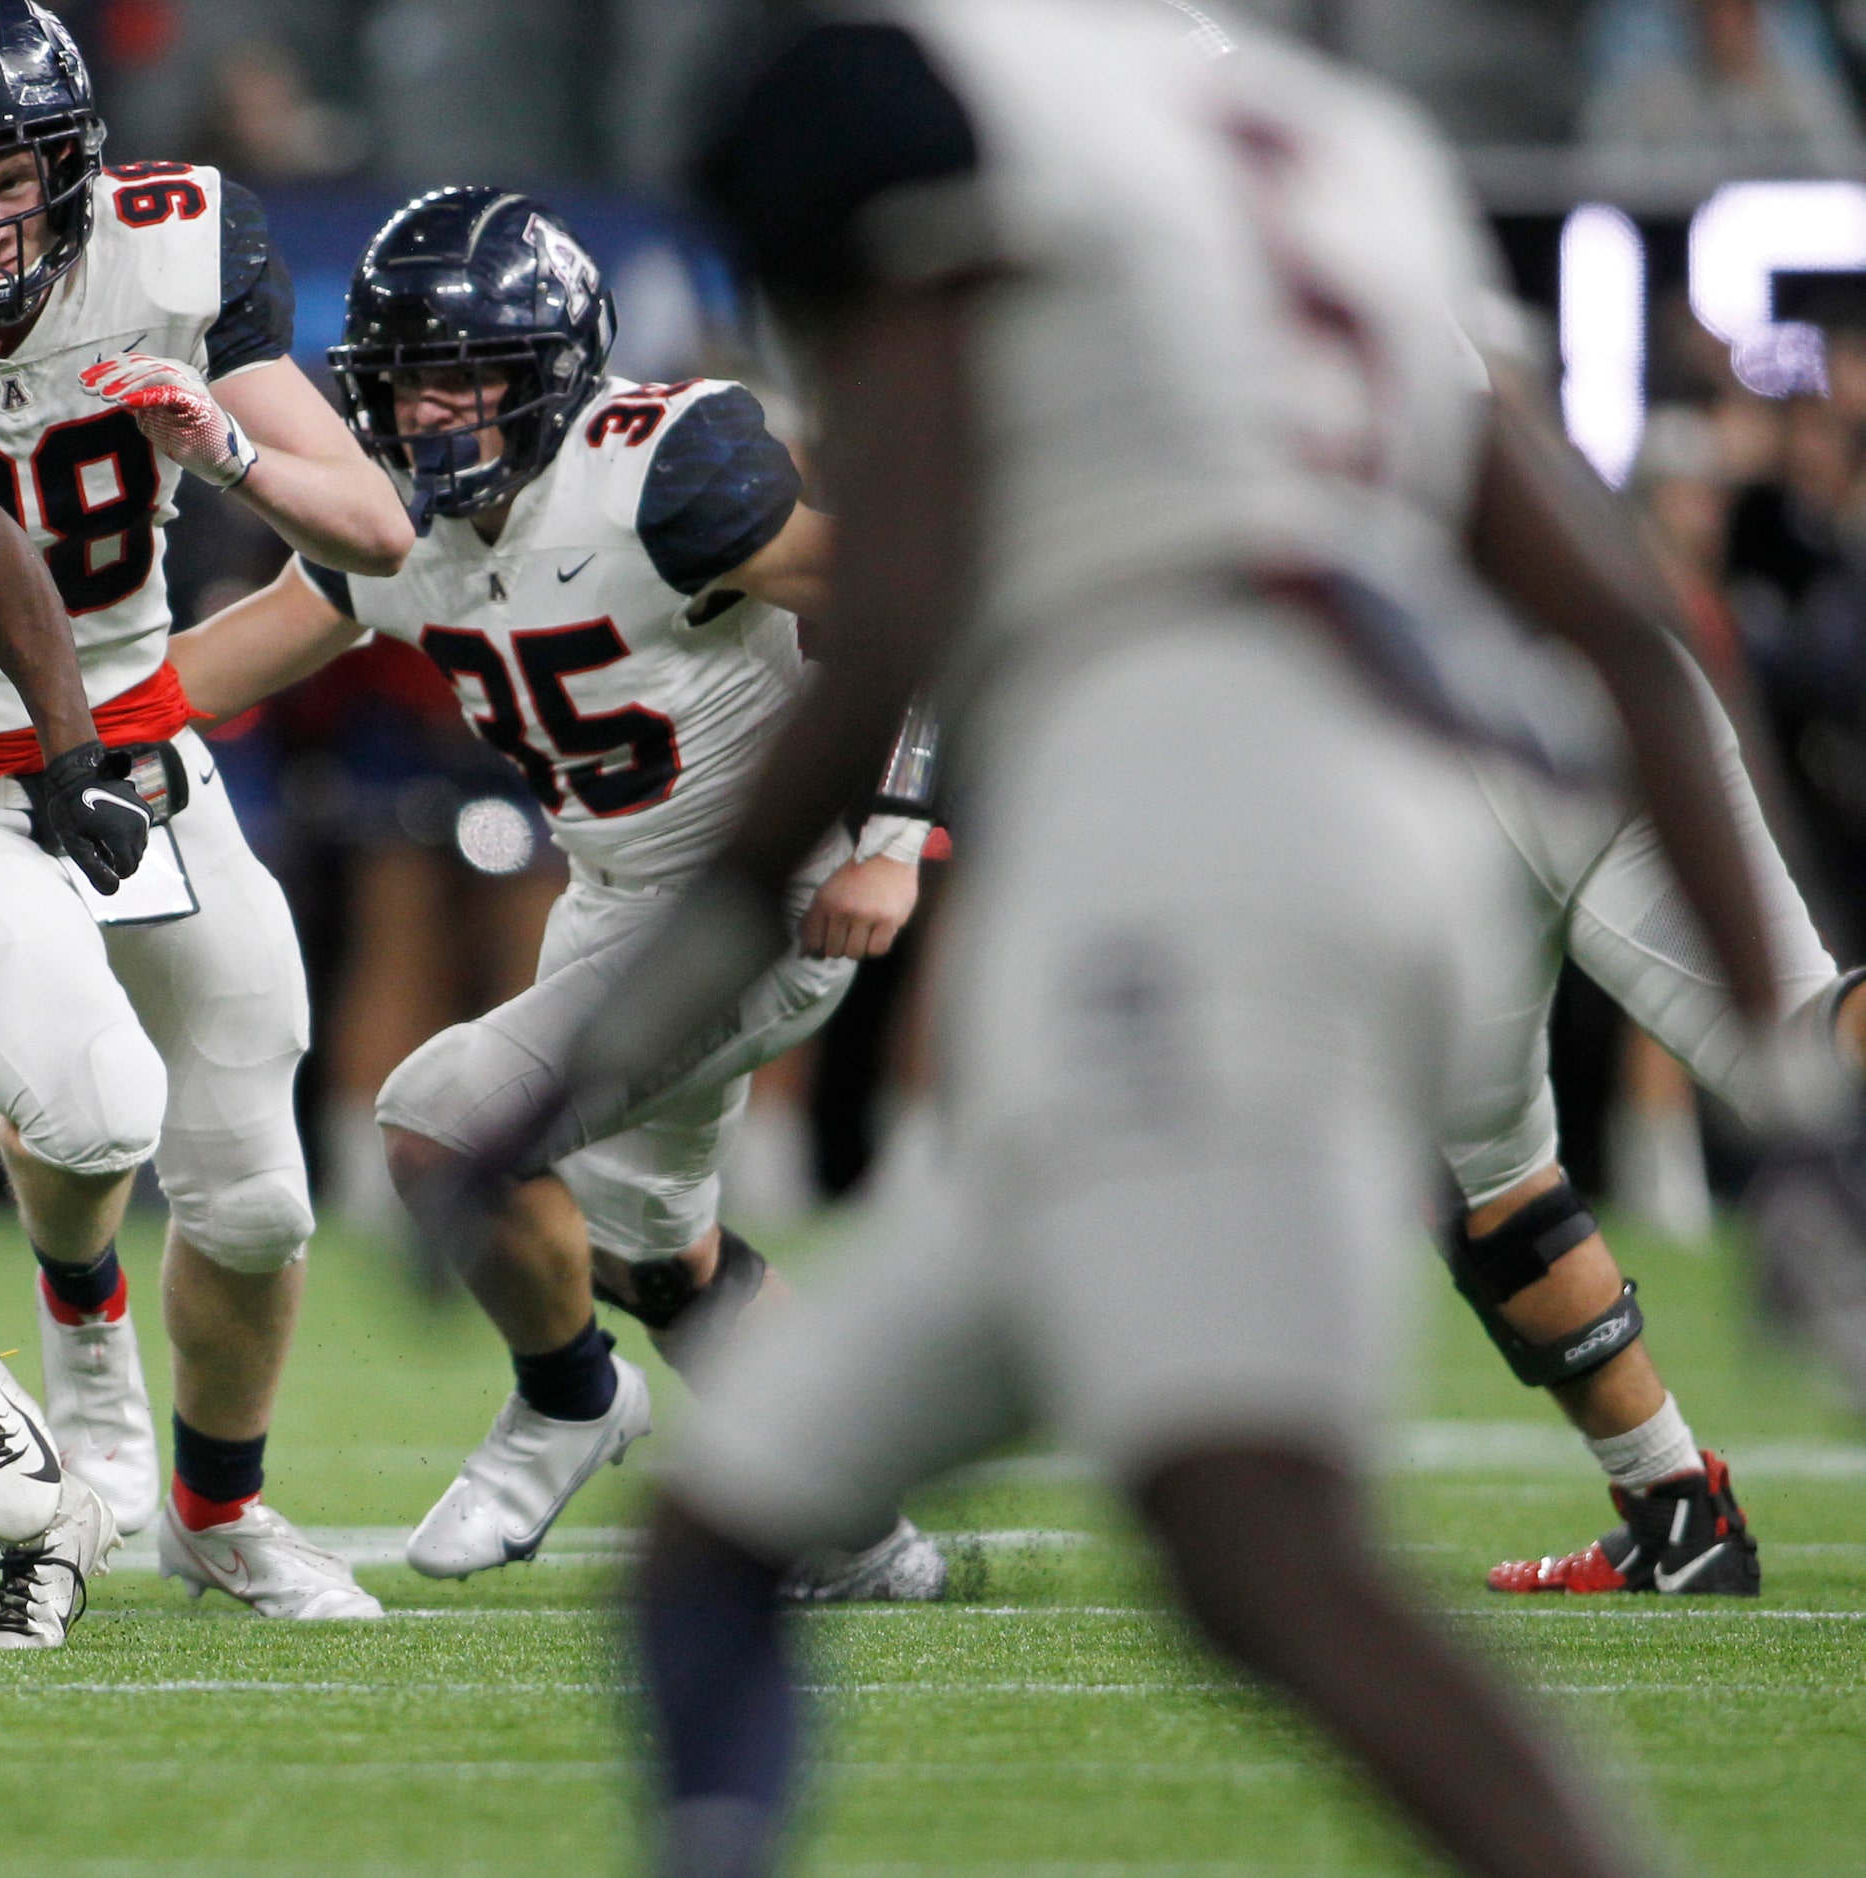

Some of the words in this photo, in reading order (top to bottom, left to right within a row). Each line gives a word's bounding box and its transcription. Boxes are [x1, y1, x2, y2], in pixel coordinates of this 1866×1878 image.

[522, 212, 600, 325] A
[2, 376, 30, 410] A
[487, 570, 509, 603] A
[419, 615, 682, 818] 35
